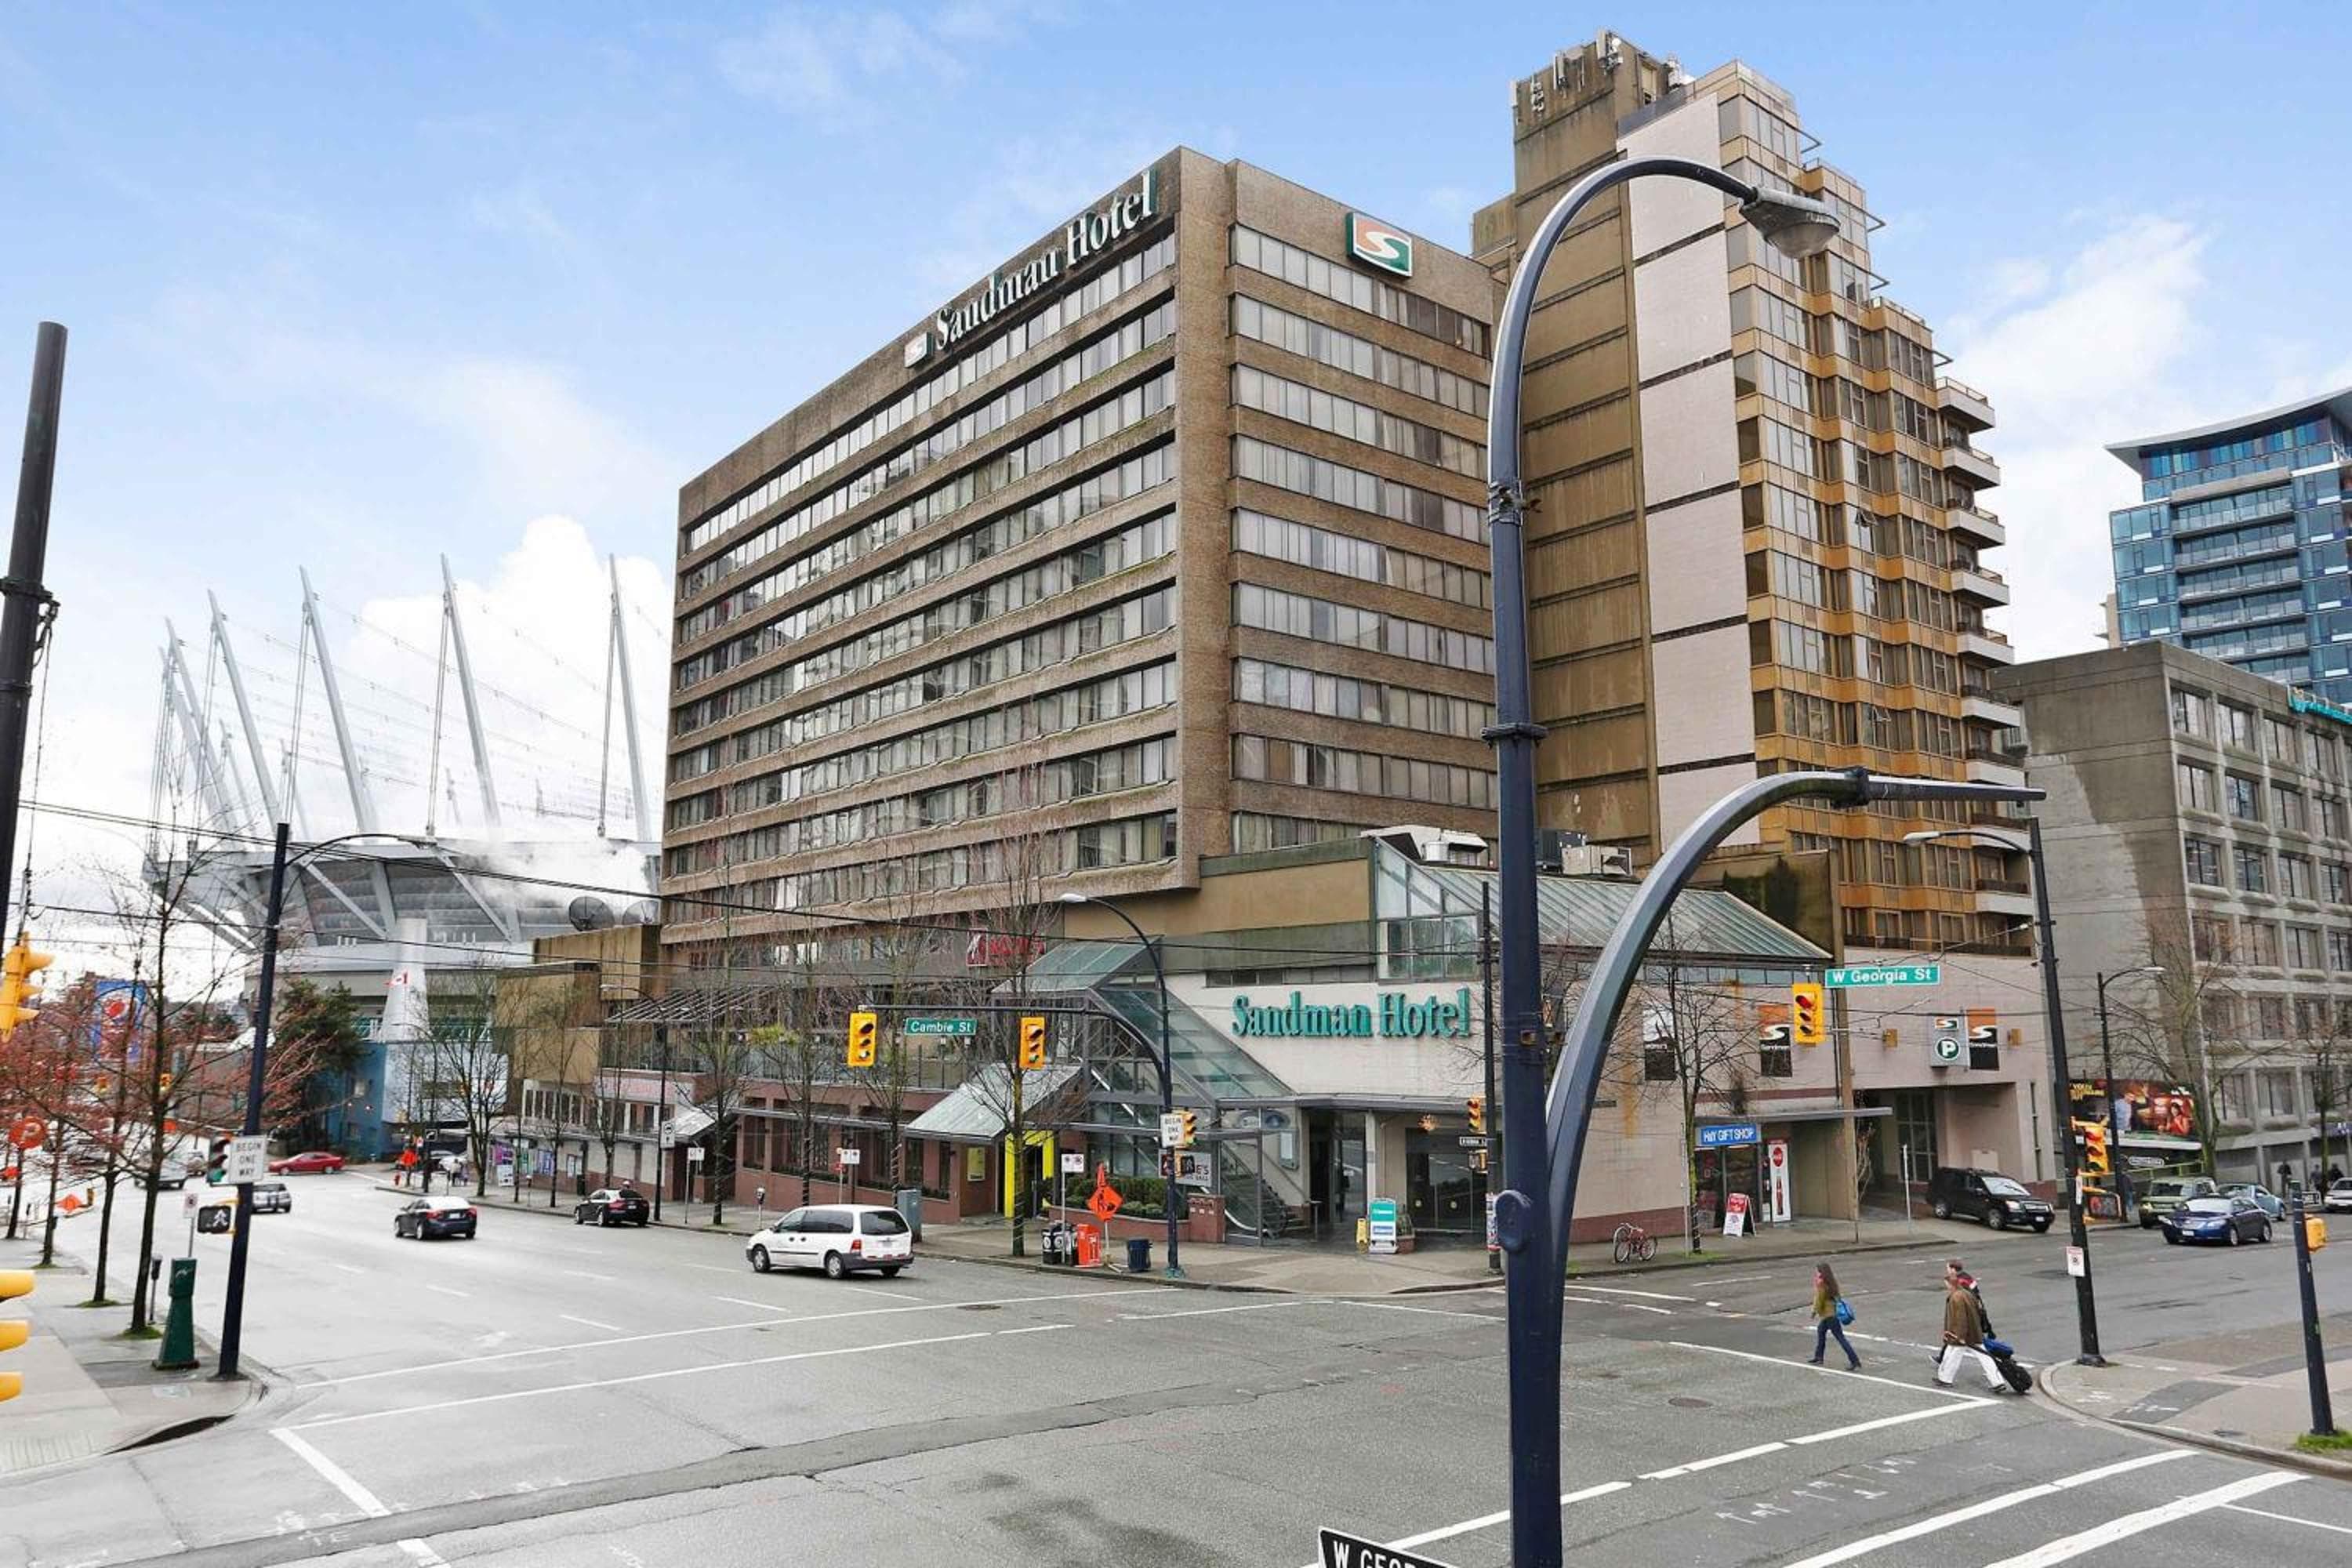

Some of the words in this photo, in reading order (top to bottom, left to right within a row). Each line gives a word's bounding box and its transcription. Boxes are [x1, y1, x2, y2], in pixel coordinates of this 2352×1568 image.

[935, 245, 1065, 351] Sandman
[1066, 168, 1159, 269] Hotel
[1832, 971, 1845, 983] W
[1851, 969, 1907, 984] Georgia
[1914, 968, 1931, 980] St
[1232, 989, 1374, 1038] Sandman
[1377, 985, 1471, 1038] Hotel
[910, 1021, 954, 1033] Cambie
[959, 1022, 971, 1033] St
[1941, 1040, 1957, 1057] P
[1733, 1128, 1755, 1140] SHOP
[239, 1155, 256, 1164] ONE
[1360, 1549, 1417, 1568] GE
